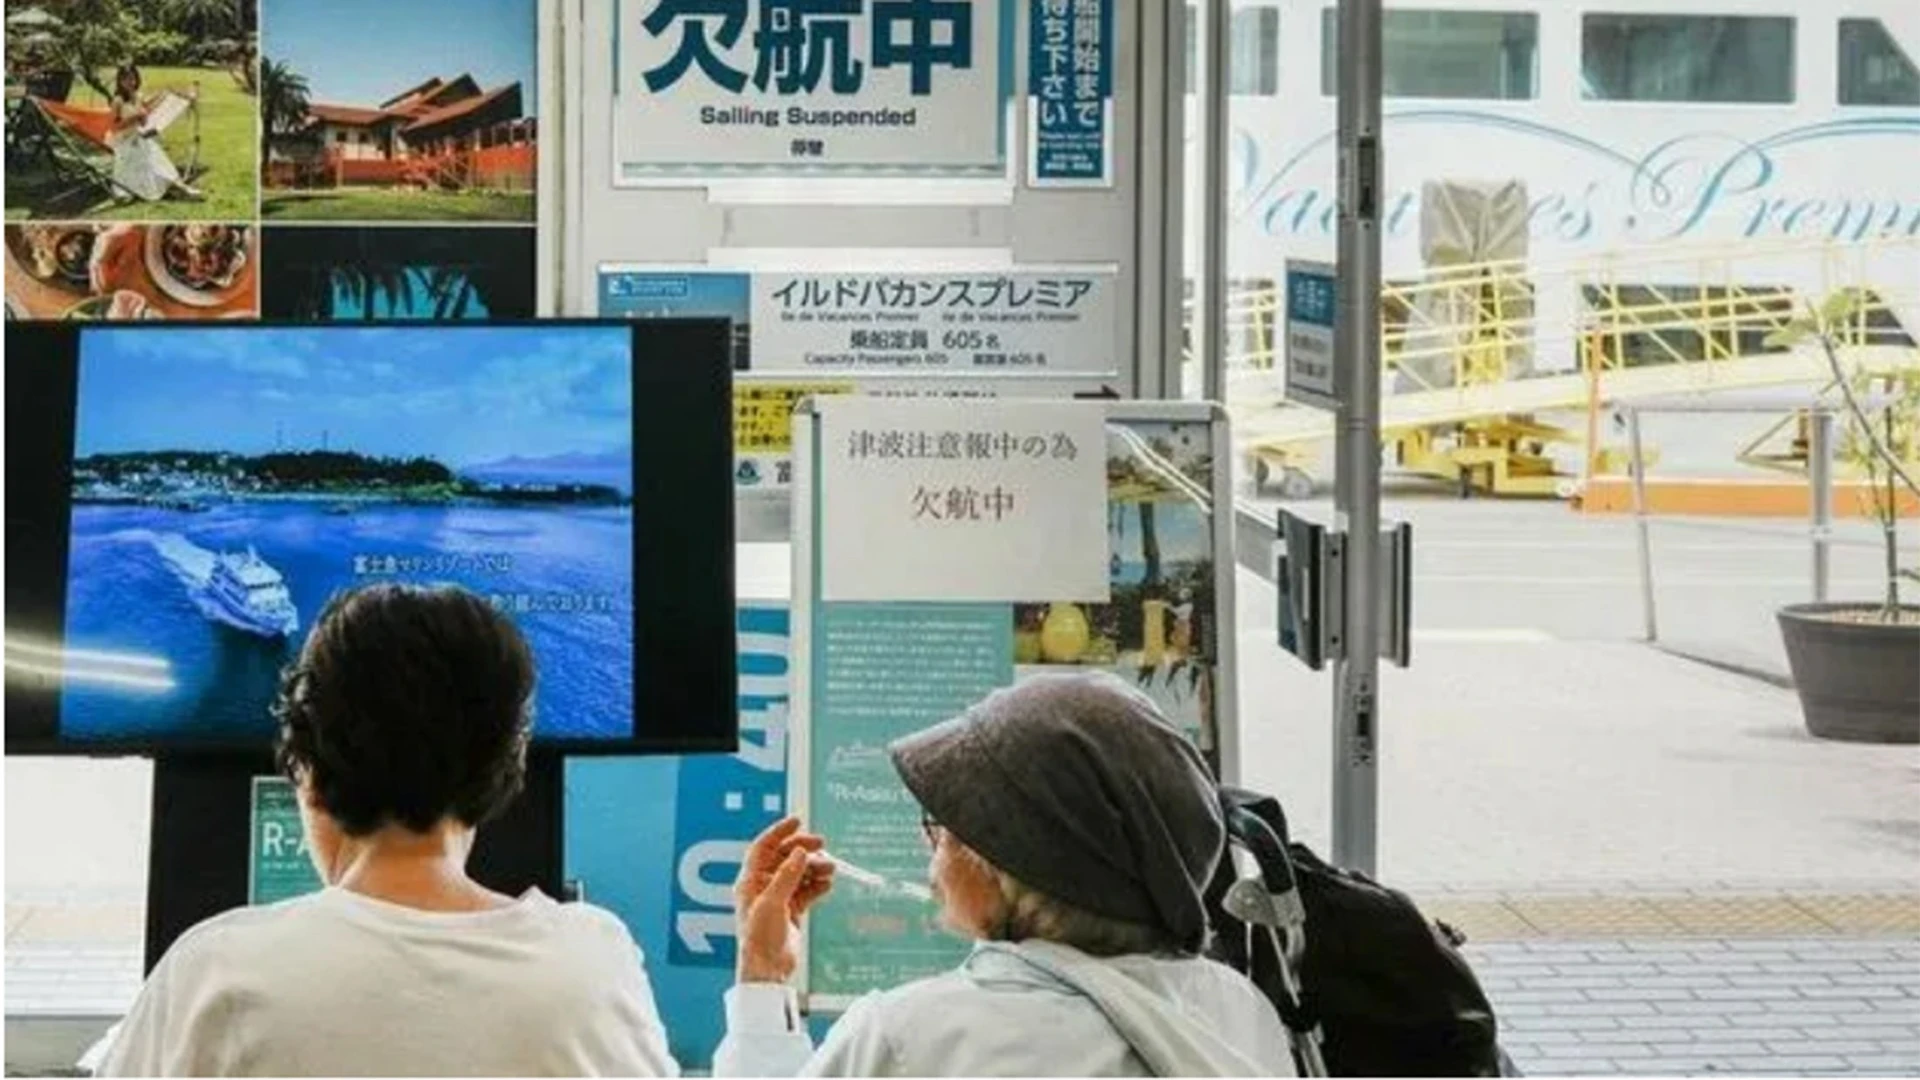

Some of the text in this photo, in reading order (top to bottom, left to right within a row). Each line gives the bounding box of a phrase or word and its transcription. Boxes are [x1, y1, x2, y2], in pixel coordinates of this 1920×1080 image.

[641, 0, 973, 95] 欠航中
[700, 106, 917, 127] Sailing Suspended
[772, 278, 1093, 308] イルドバカンスプレミア
[848, 429, 1078, 461] 津波注意報中の為
[911, 484, 1014, 521] 欠航中
